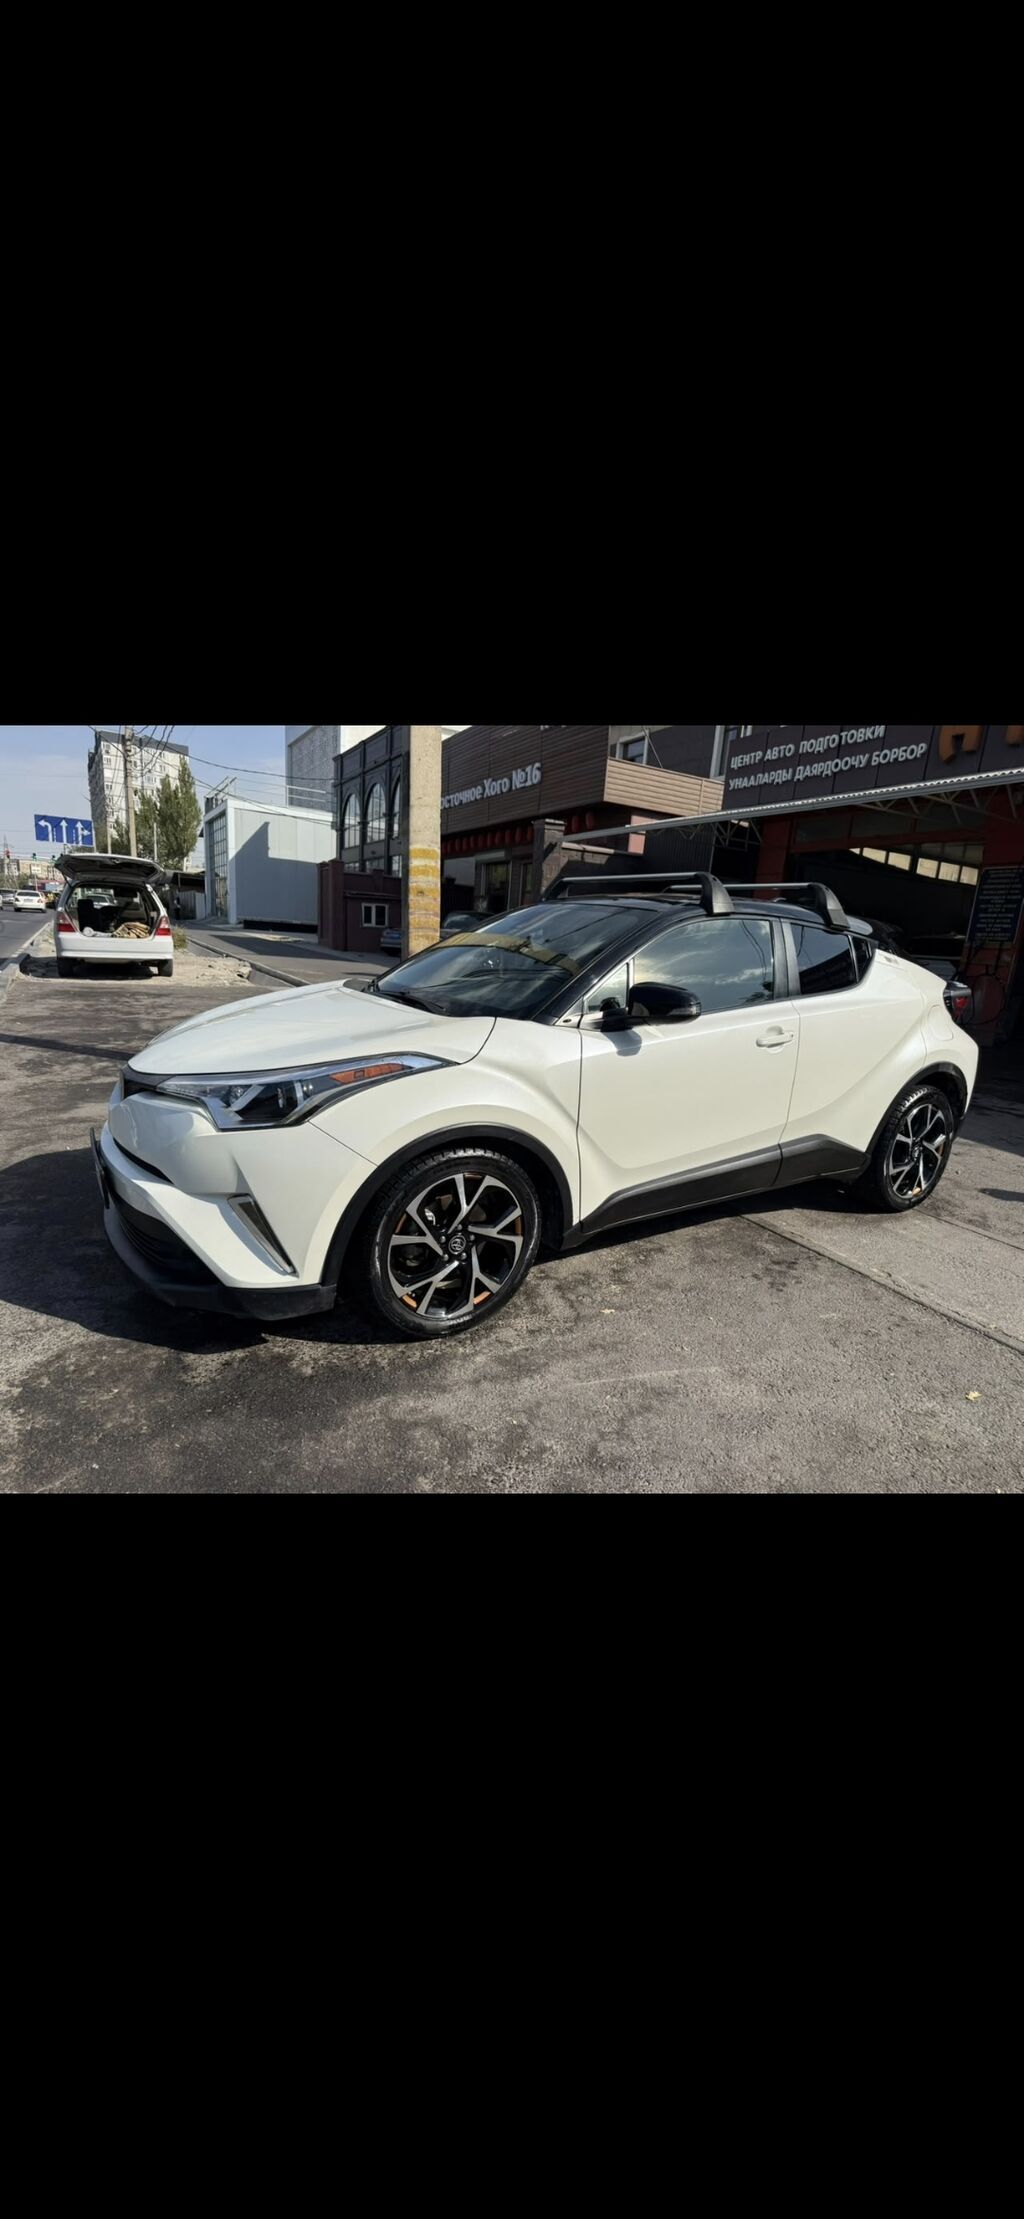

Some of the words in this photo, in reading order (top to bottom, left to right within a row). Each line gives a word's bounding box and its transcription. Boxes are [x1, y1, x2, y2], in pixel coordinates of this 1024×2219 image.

[731, 750, 763, 770] ЦЕНТР
[765, 743, 795, 762] АВТО
[794, 753, 869, 782] ДАЯРДООЧУ
[871, 742, 927, 766] БОРБОР
[483, 778, 510, 798] Хого
[511, 762, 542, 790] №16
